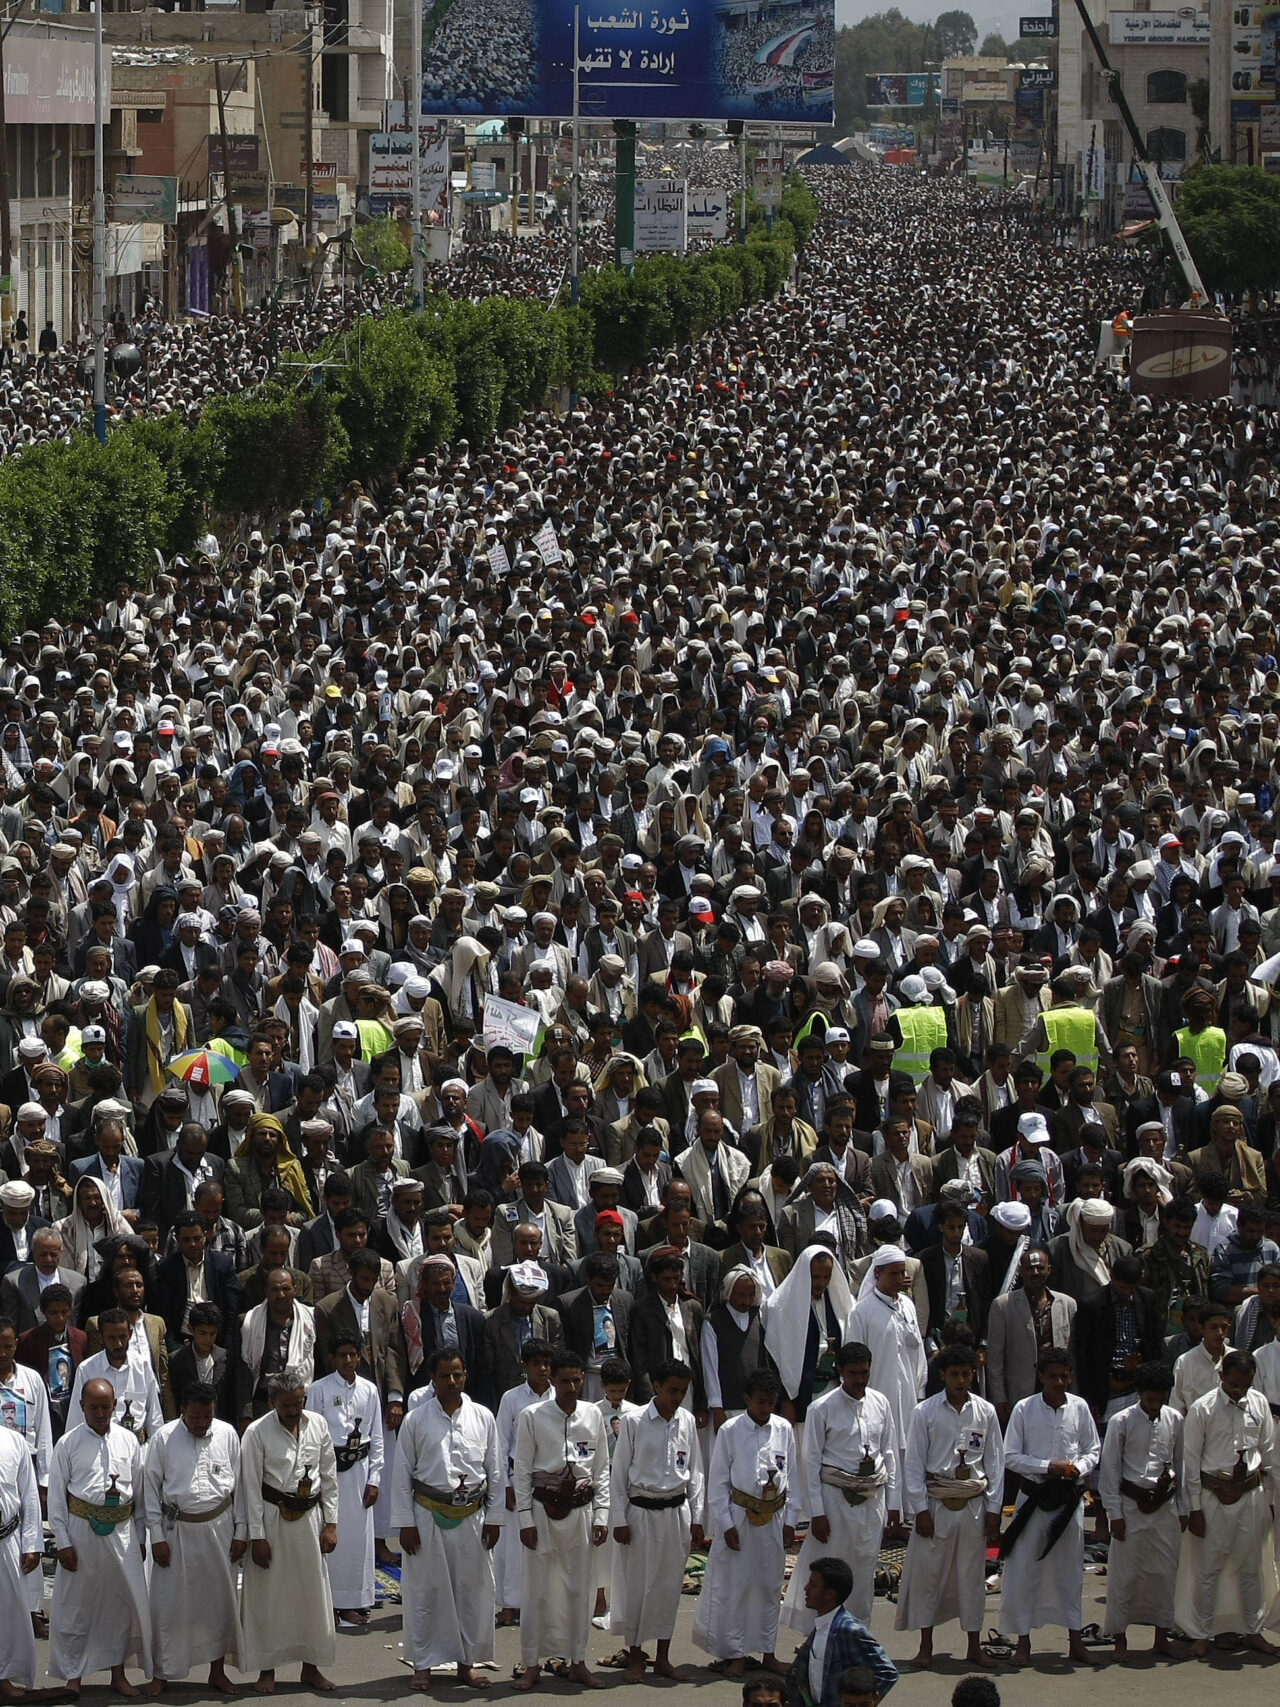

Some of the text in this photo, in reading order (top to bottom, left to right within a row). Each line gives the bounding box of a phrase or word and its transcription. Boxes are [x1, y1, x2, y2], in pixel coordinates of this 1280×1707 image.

[587, 8, 690, 35] ثورة الشعب
[1022, 19, 1054, 36] وأجنحة
[1125, 19, 1210, 31] يمنية للخدمات الأرضية
[619, 48, 633, 69] لا
[640, 49, 675, 74] إرادة
[1021, 70, 1054, 88] ليبرتي
[372, 136, 413, 159] صيدلية
[117, 184, 162, 196] صيدلية
[656, 182, 684, 194] ملك
[634, 198, 683, 214] النظارات
